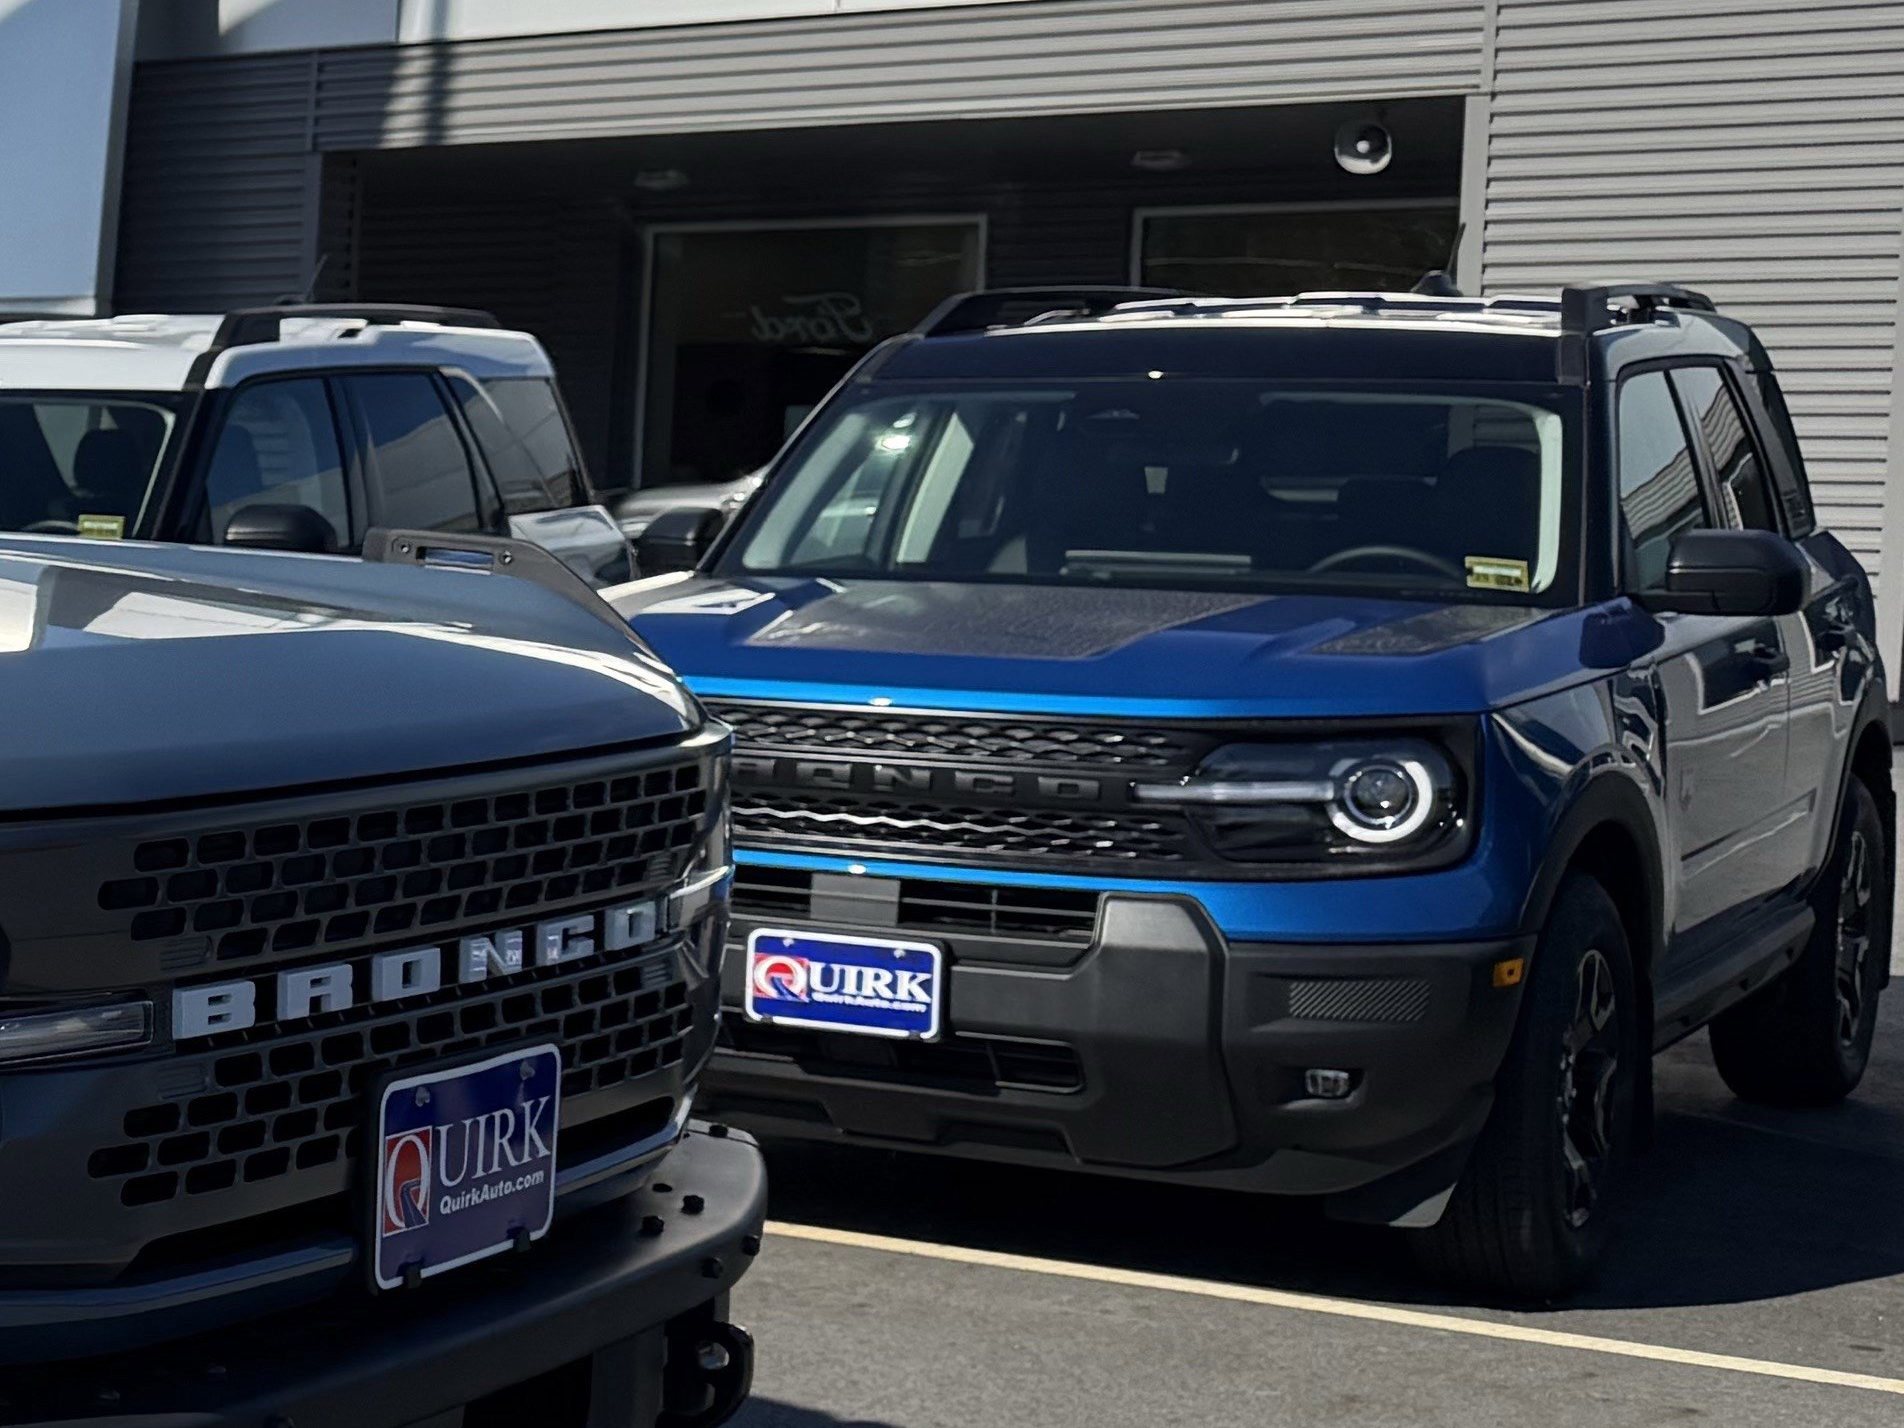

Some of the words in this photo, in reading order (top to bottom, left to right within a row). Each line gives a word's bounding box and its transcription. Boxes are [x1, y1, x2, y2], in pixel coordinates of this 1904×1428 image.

[172, 900, 657, 1041] BRONCO
[754, 955, 933, 1004] QUIRK
[385, 1095, 552, 1229] QUIRK
[439, 1170, 545, 1215] QuirkAuto.com
